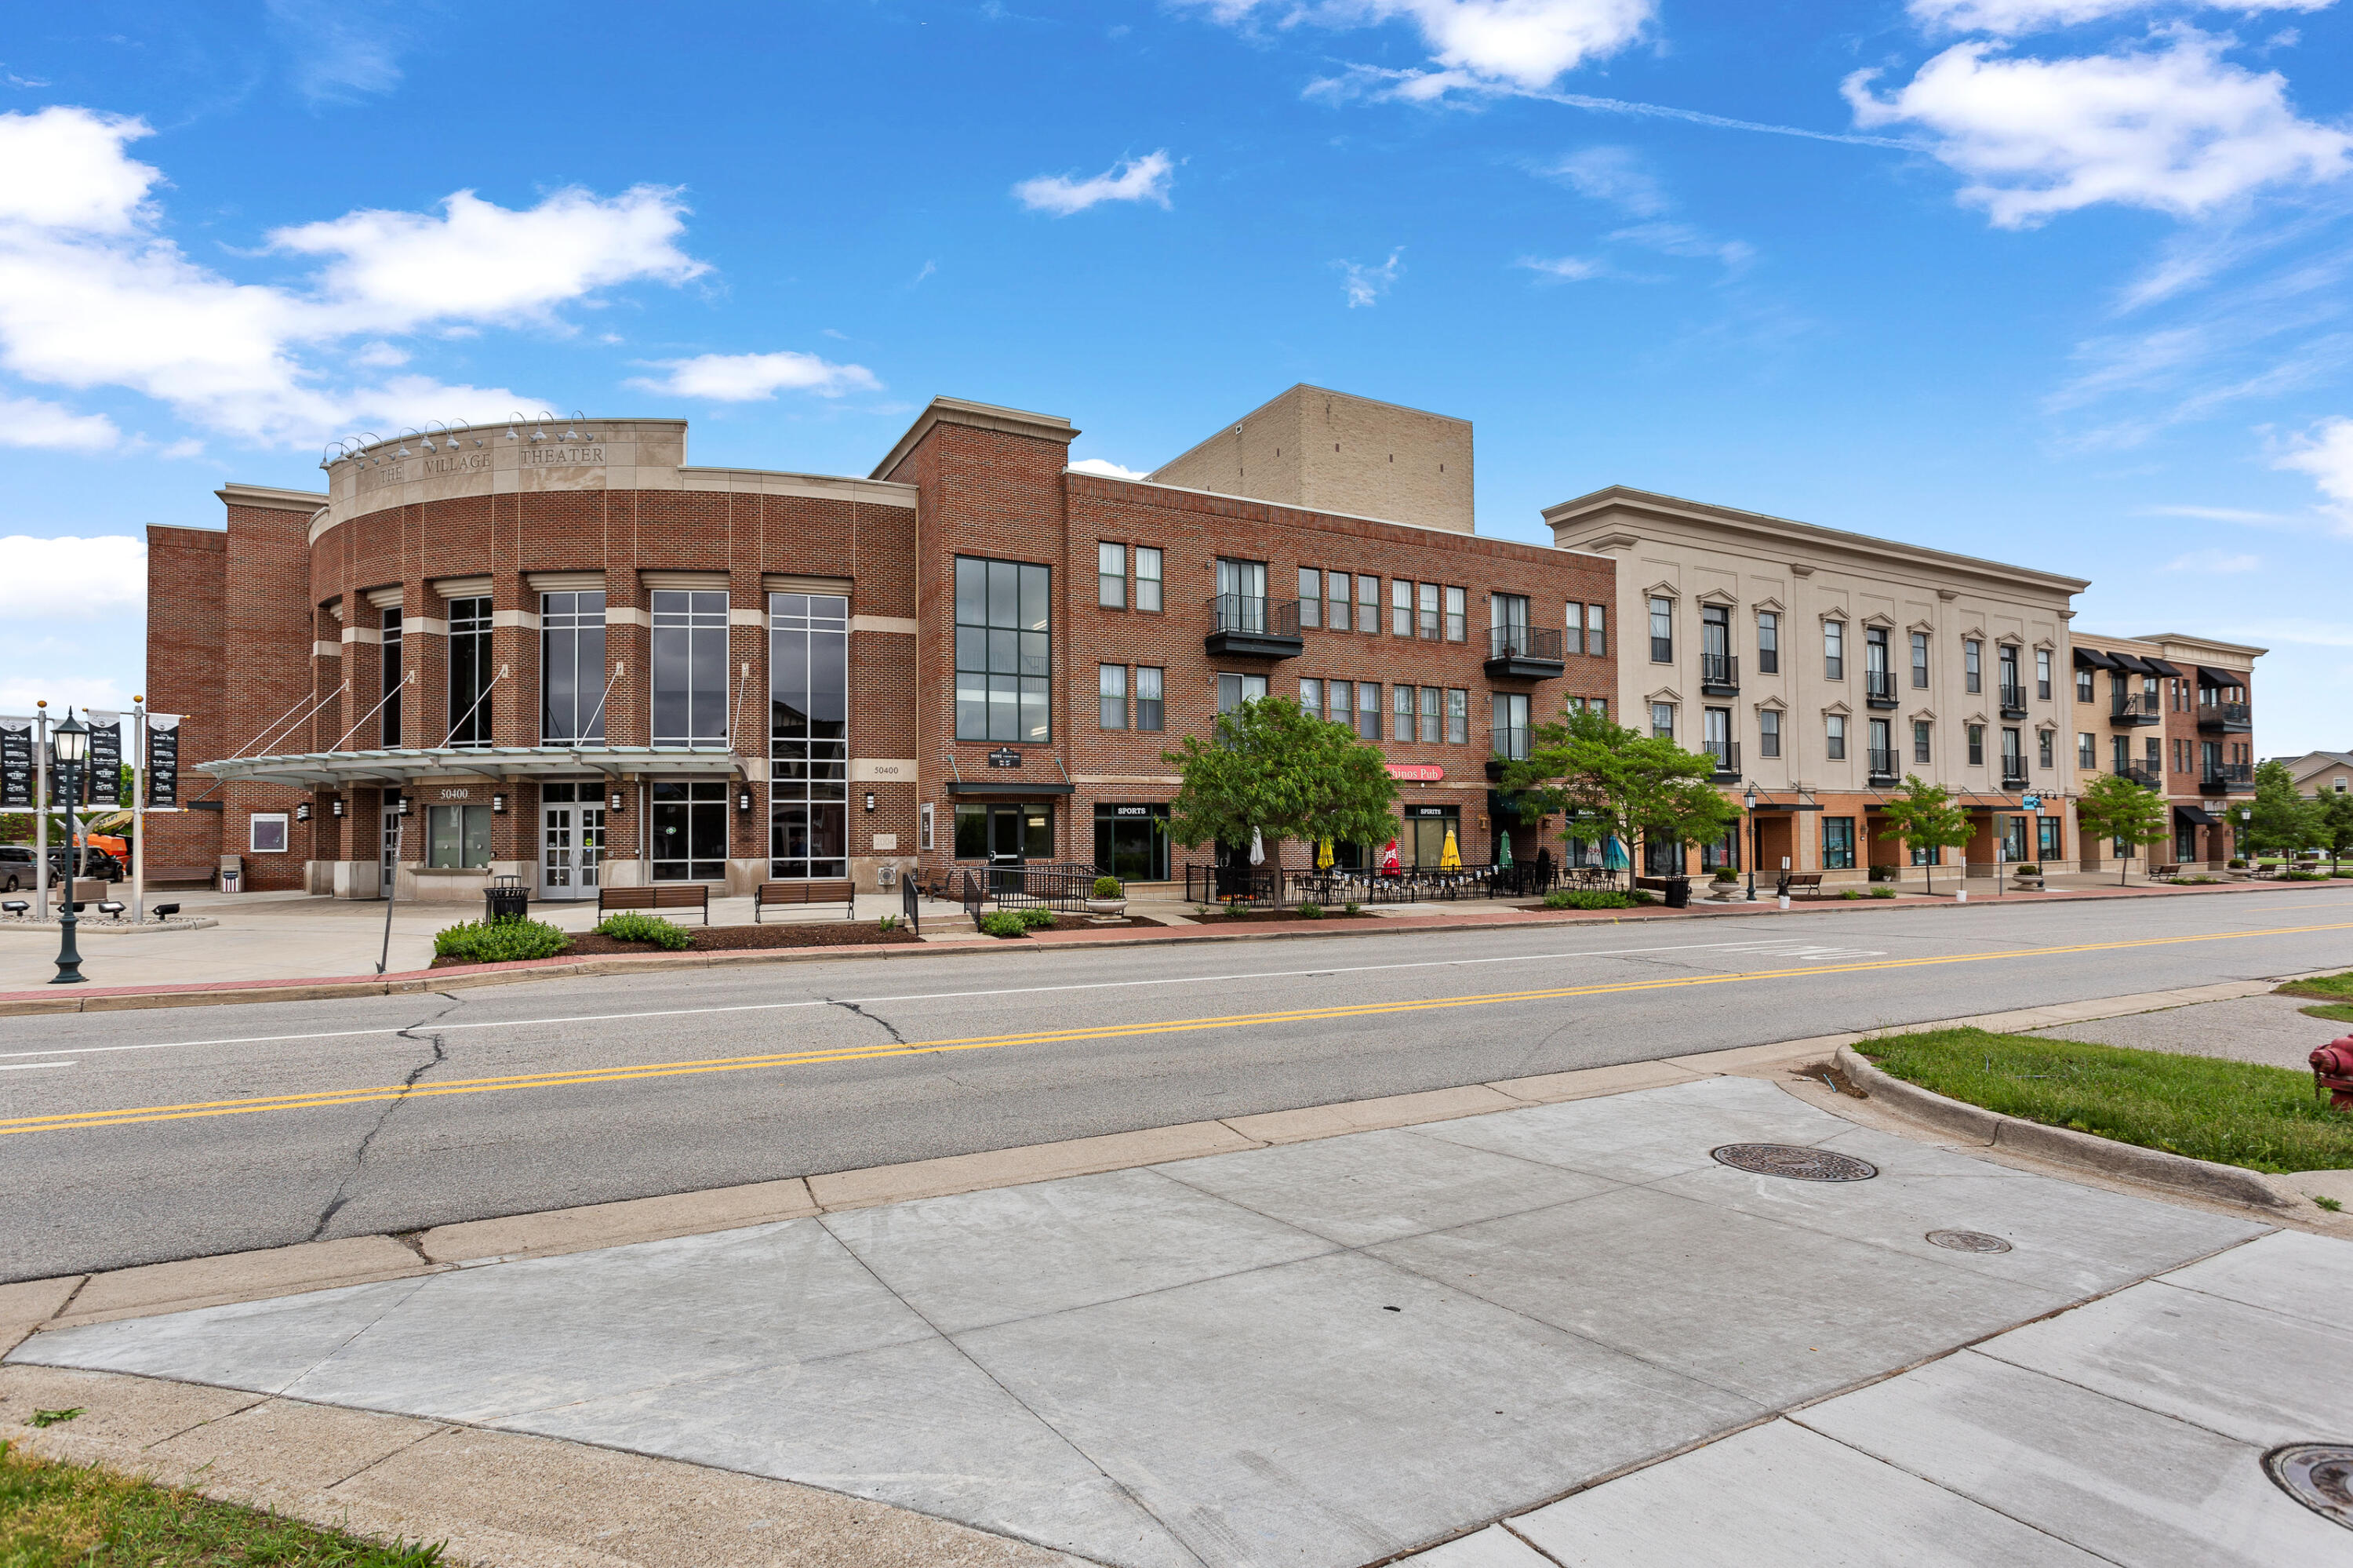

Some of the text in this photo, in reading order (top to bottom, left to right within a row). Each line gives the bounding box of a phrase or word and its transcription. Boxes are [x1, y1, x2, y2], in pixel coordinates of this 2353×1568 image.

[380, 448, 604, 482] THE VILLAGE THEATER
[1389, 768, 1438, 779] hinos Pub
[440, 788, 468, 799] 50400
